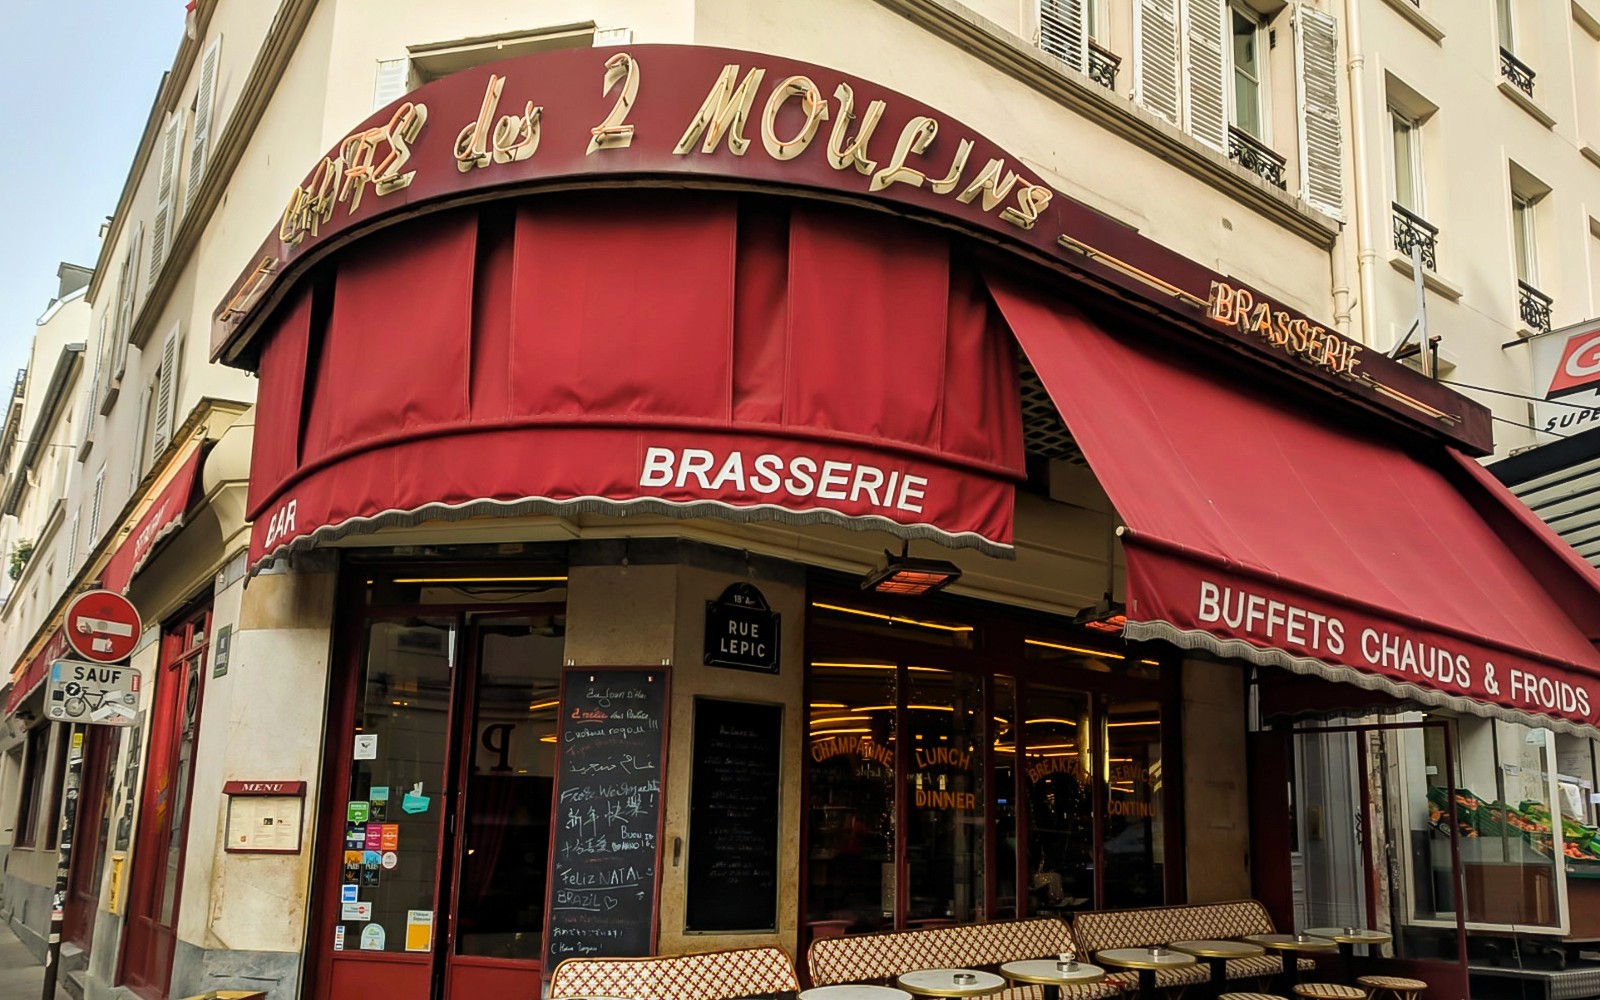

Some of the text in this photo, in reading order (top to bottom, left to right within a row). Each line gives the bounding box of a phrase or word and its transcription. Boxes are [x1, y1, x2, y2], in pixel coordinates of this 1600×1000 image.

[453, 73, 544, 173] des
[585, 52, 641, 156] 2
[671, 64, 1053, 230] MOULINS
[1210, 280, 1364, 380] BRASSERIE
[640, 446, 929, 514] BRASSERIE
[264, 499, 298, 548] BAR
[728, 620, 759, 638] RUE
[720, 638, 766, 658] LEPIC
[1198, 580, 1592, 717] BUFFETS CHAUDS & FROIDS
[73, 666, 122, 685] SAUF
[811, 735, 896, 768] CHAMPAGNE
[914, 746, 971, 770] LUNCH
[241, 783, 283, 792] MENU
[915, 790, 976, 810] DINNER
[599, 866, 644, 885] NATAL
